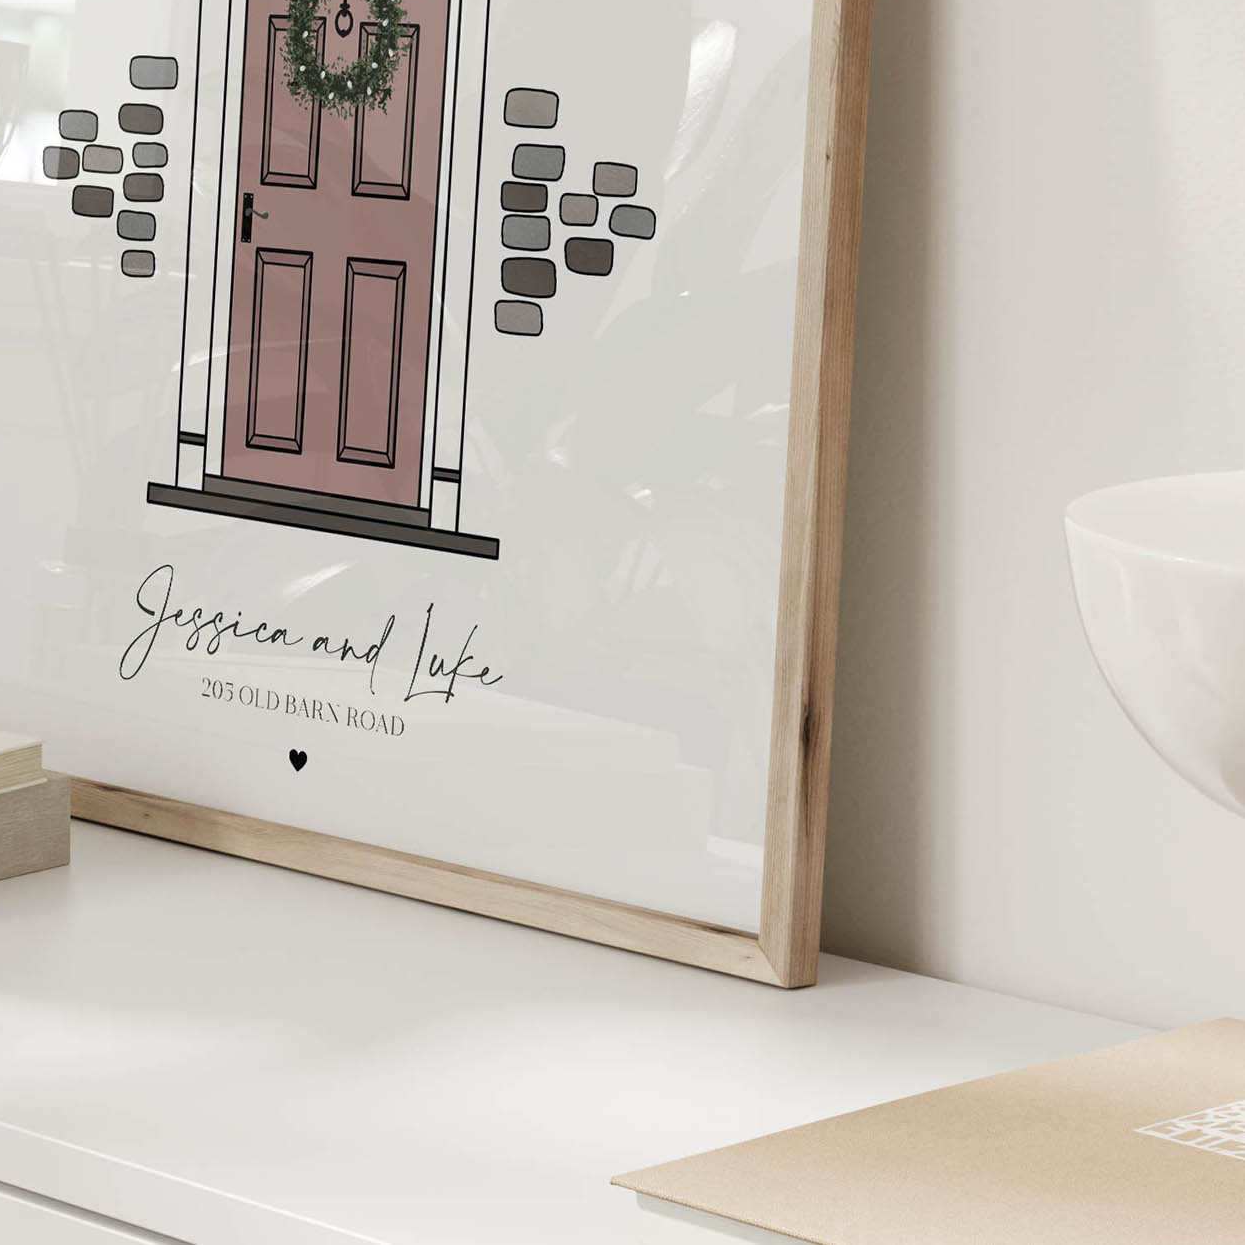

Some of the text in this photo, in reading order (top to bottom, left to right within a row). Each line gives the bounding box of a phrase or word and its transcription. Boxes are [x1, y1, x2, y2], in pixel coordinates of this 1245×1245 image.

[119, 564, 504, 703] Jessica and Luke
[201, 678, 405, 736] 205 OLD BARN ROAD
